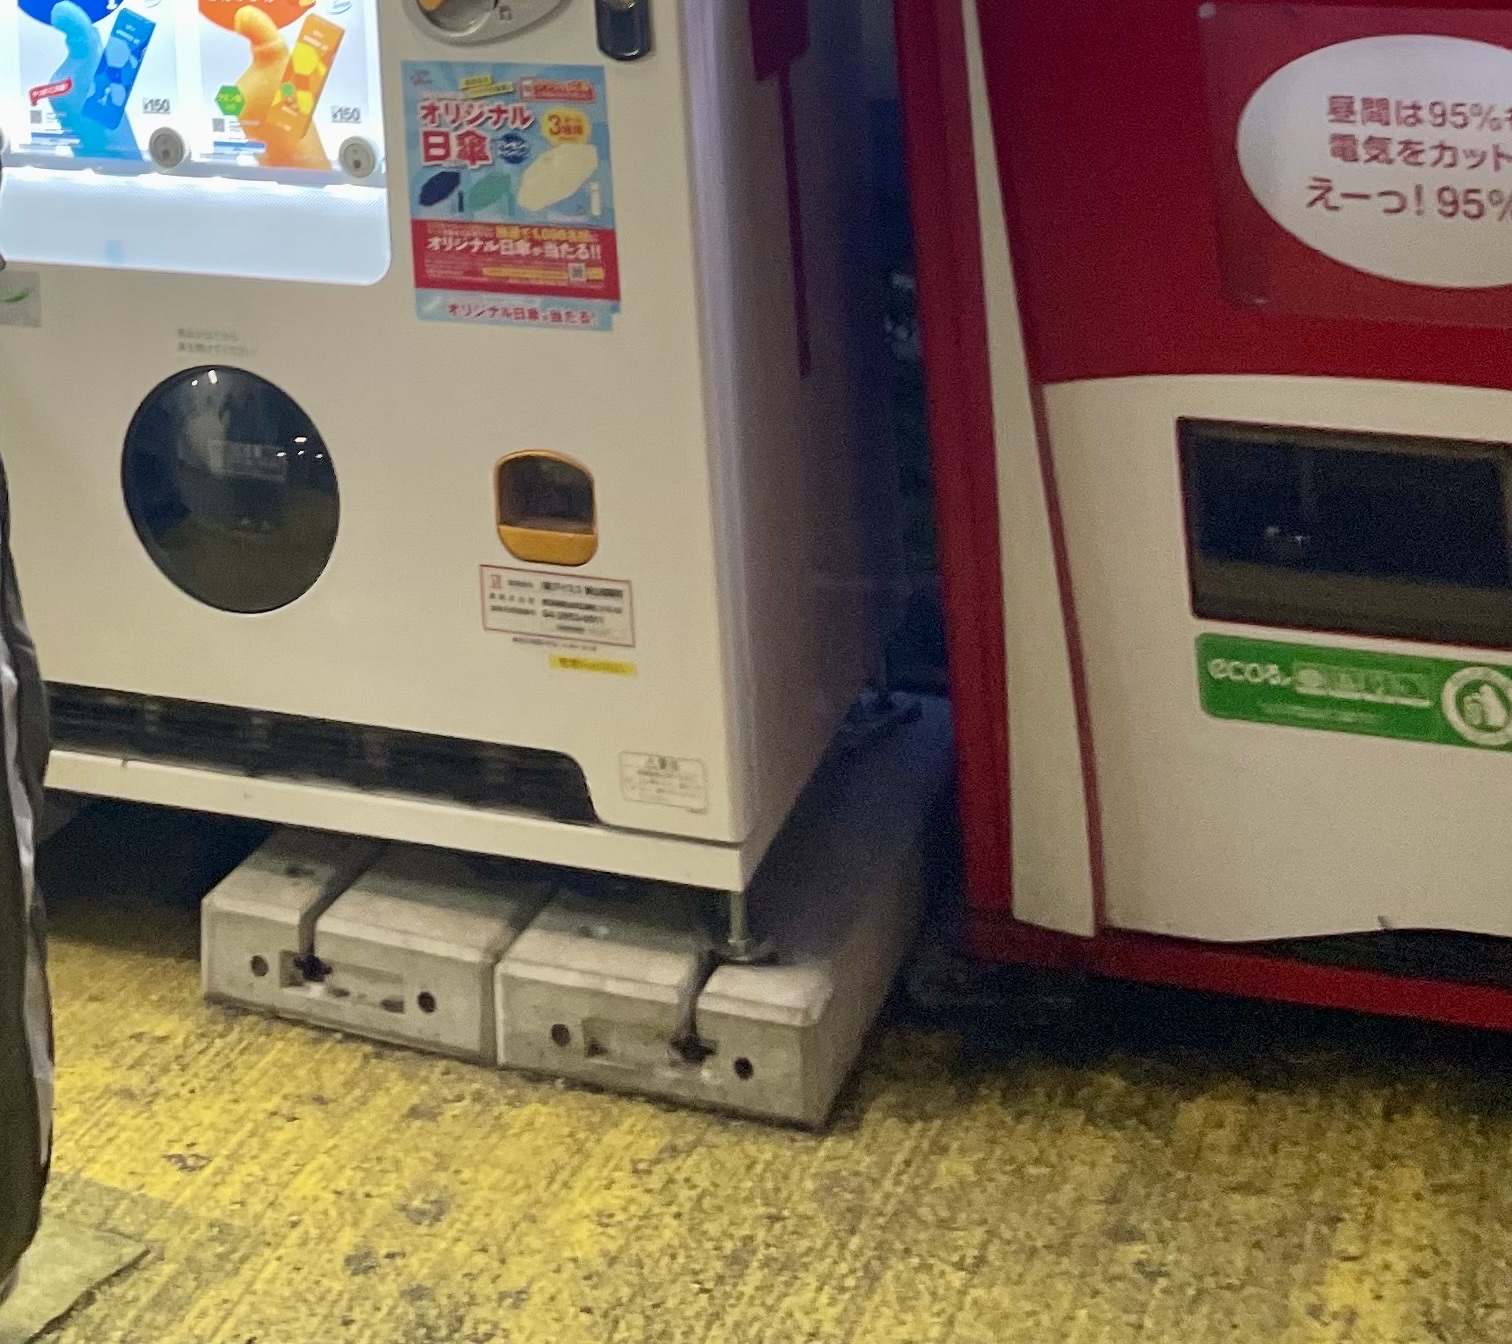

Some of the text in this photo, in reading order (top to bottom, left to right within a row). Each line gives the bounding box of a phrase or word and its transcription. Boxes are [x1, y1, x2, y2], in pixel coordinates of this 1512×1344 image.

[419, 102, 534, 128] オリジナル
[422, 129, 490, 165] 日傘
